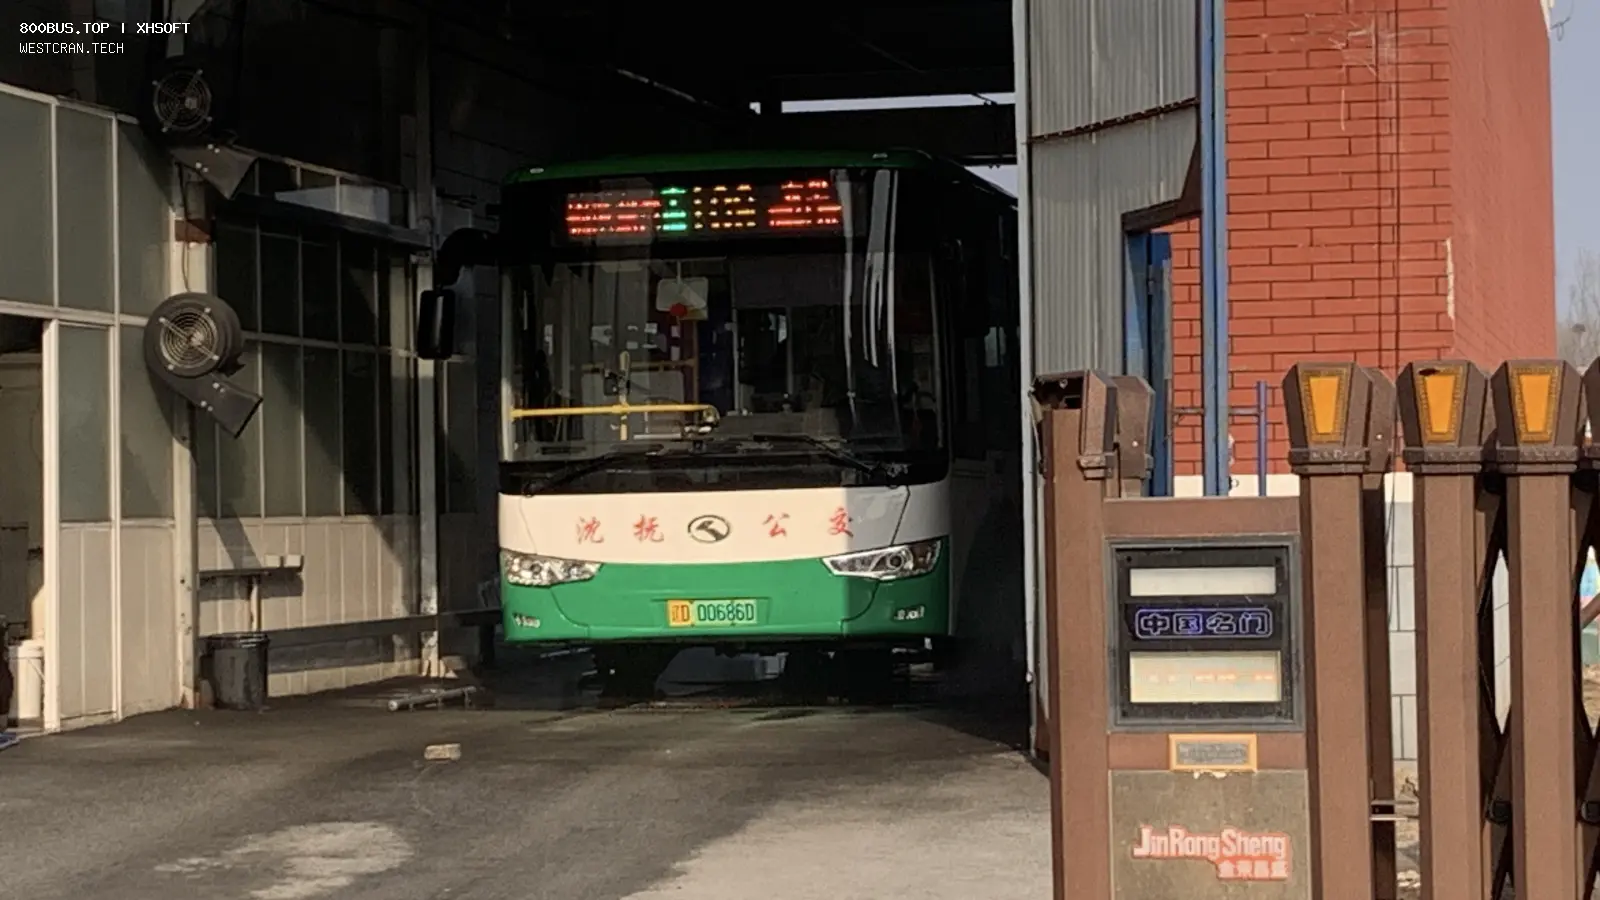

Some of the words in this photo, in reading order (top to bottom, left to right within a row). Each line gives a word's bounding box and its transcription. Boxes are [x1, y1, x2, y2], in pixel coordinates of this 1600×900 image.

[763, 507, 854, 538] 公交
[1140, 612, 1268, 636] 中国名门
